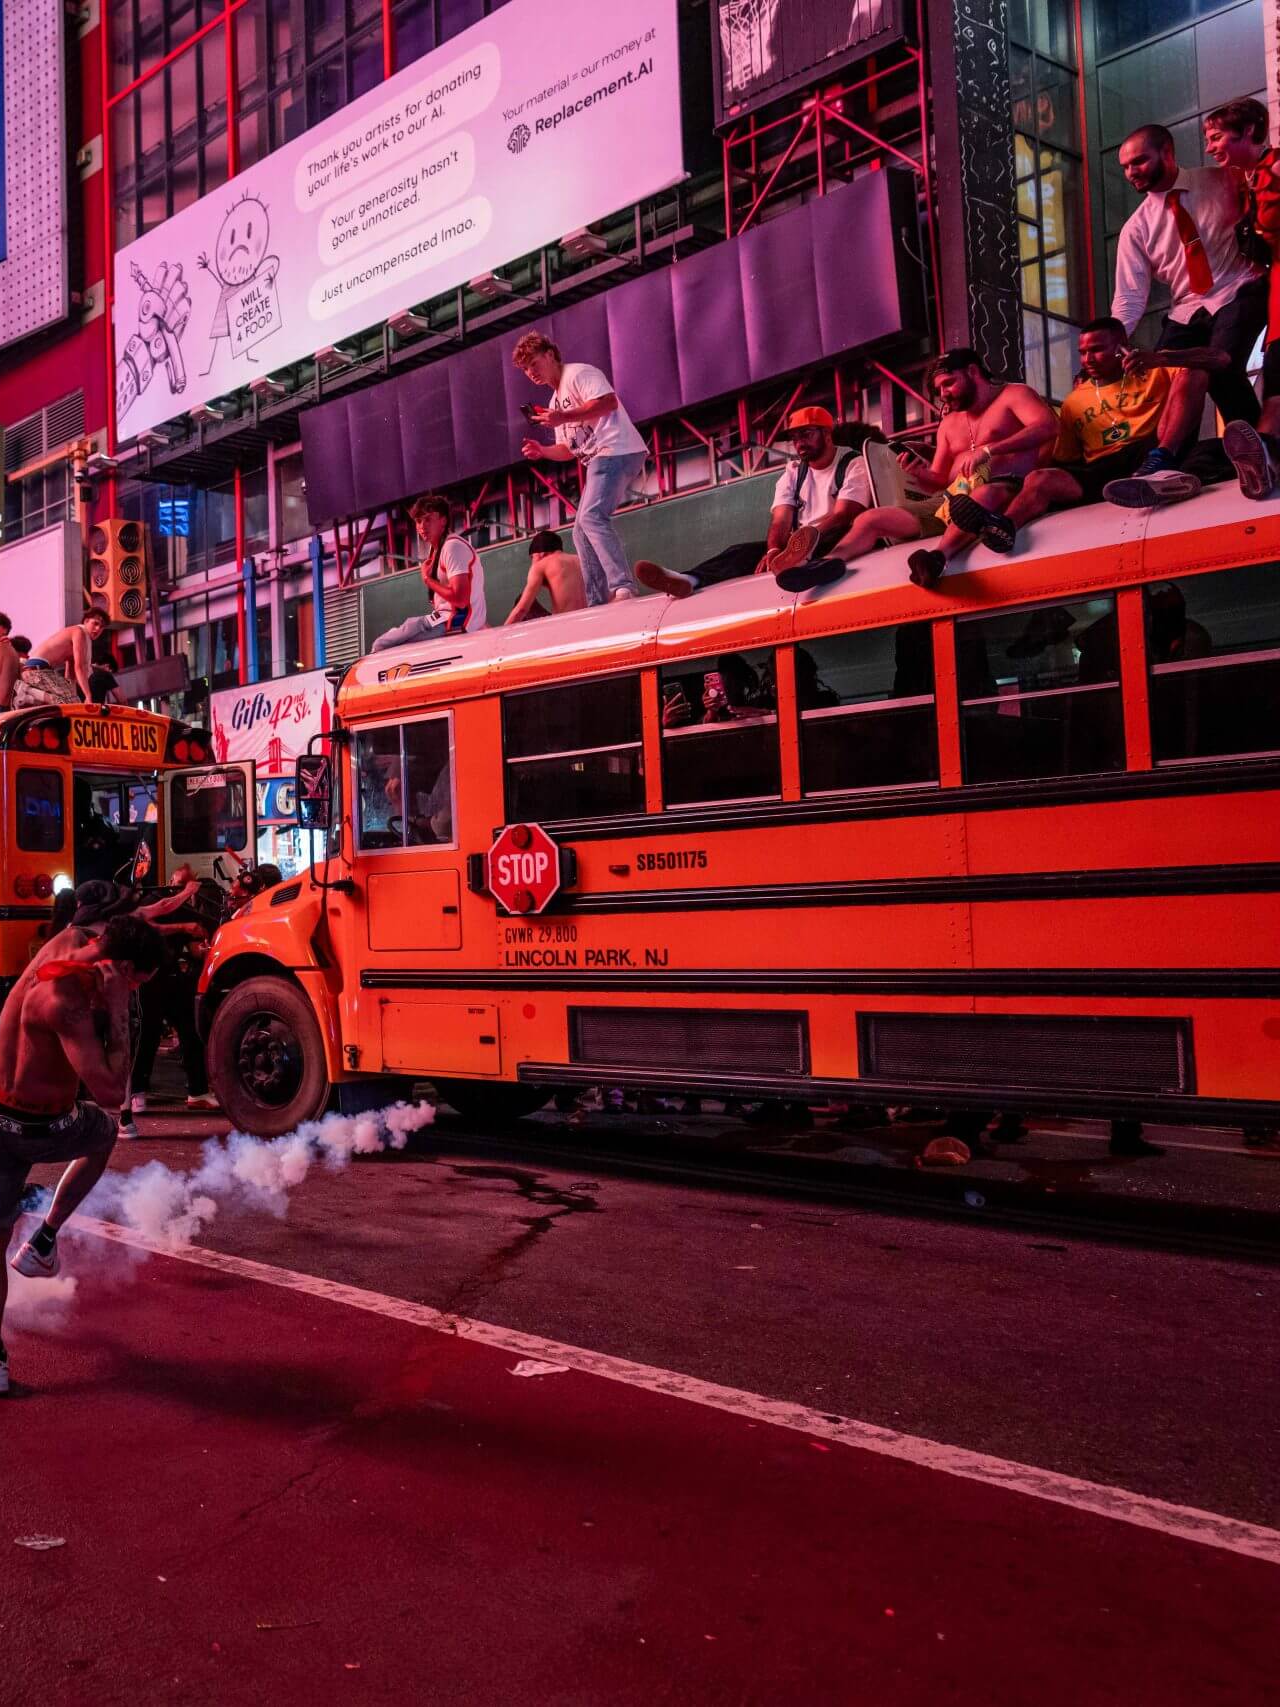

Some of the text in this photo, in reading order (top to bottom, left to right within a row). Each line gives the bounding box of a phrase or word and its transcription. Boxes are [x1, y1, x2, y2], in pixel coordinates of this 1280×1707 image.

[502, 103, 524, 122] Your
[526, 74, 571, 111] material
[580, 61, 600, 79] our
[602, 38, 643, 70] money
[645, 27, 656, 45] at
[535, 58, 654, 135] Replacement.AI
[307, 64, 483, 177] Thank you artists for donating
[308, 103, 447, 197] your life's work to our AI.
[331, 149, 460, 230] Your generosity hasn't
[331, 190, 421, 250] gone unnoticed.
[321, 216, 477, 302] Just uncompensated lmao.
[236, 295, 271, 328] CREATE
[240, 286, 263, 308] WILL
[245, 311, 273, 338] FOOD
[1074, 391, 1145, 430] BRAZI
[231, 692, 272, 730] Gifts
[73, 719, 158, 752] SCHOOL BUS
[497, 851, 549, 886] STOP
[636, 850, 708, 872] SB501175
[504, 925, 578, 945] GVWR 29,800
[505, 948, 670, 968] LINCOLN PARK, NJ
